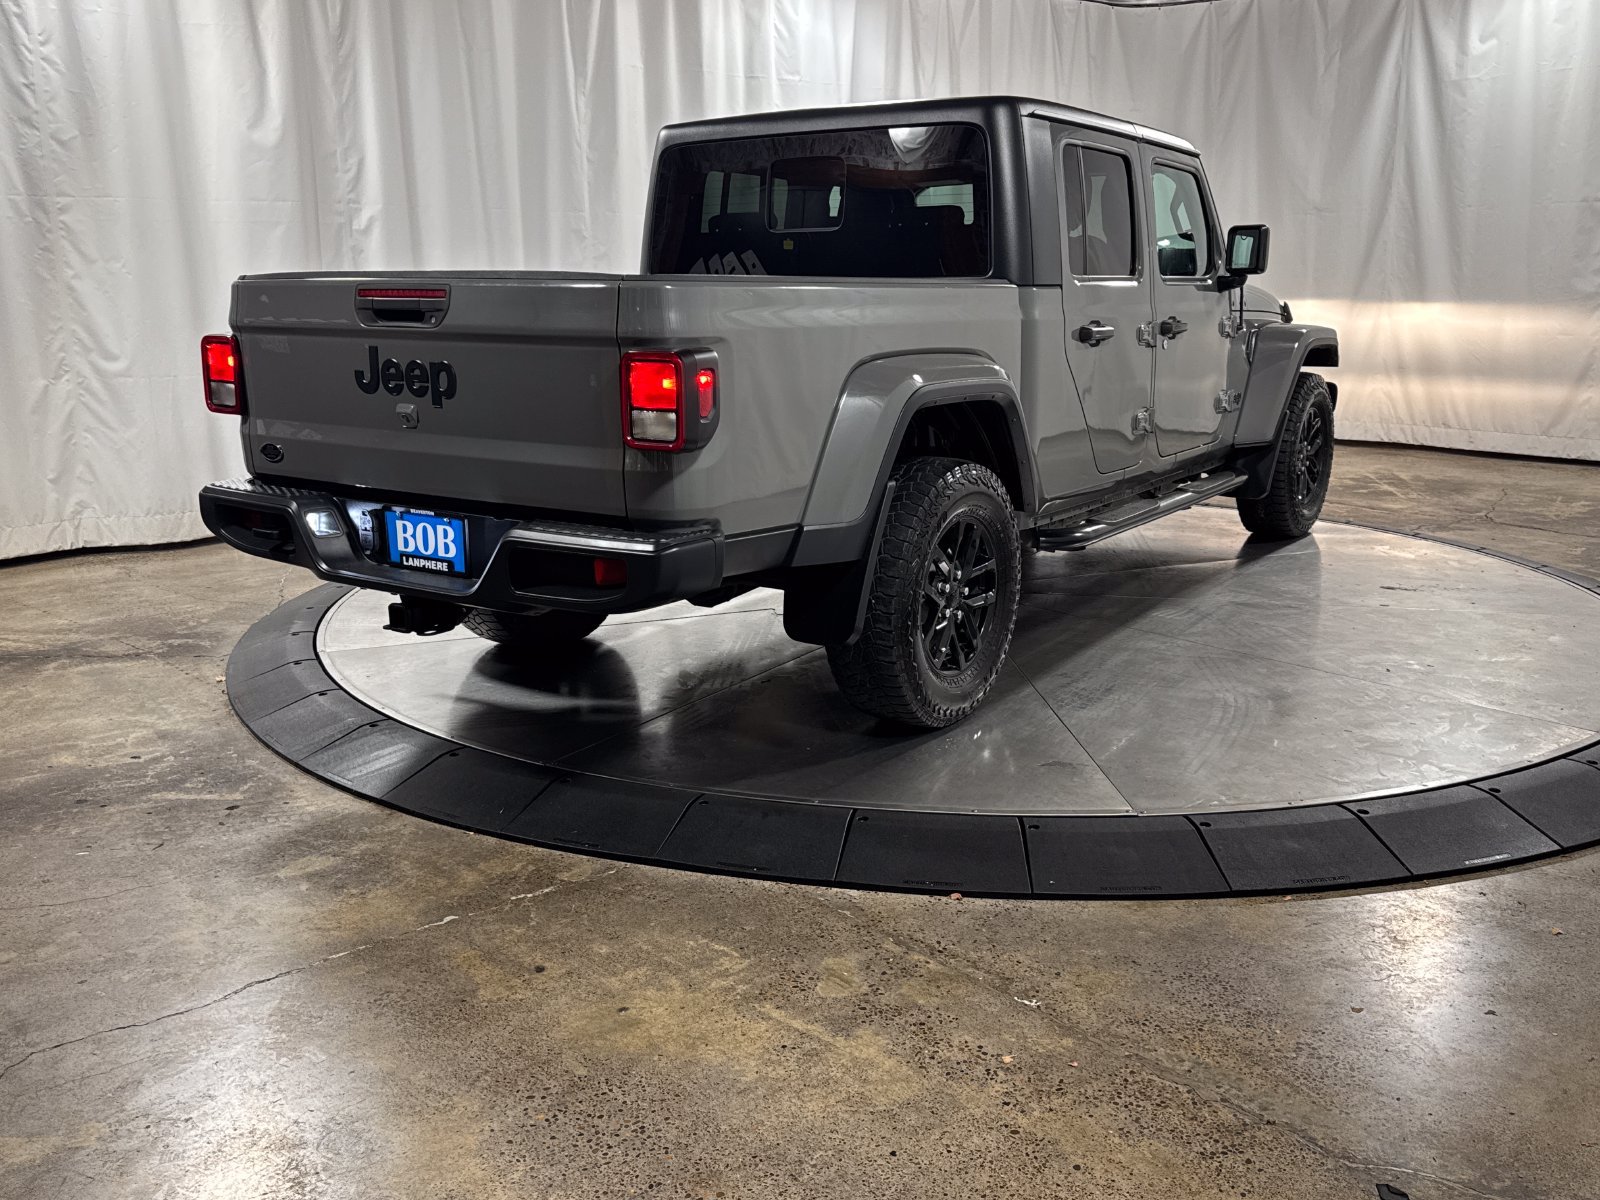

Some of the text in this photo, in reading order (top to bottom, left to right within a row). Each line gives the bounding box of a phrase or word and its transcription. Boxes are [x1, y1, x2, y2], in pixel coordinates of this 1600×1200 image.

[354, 346, 457, 409] Jeep
[395, 519, 457, 558] BOB
[402, 556, 449, 572] LANPHERE
